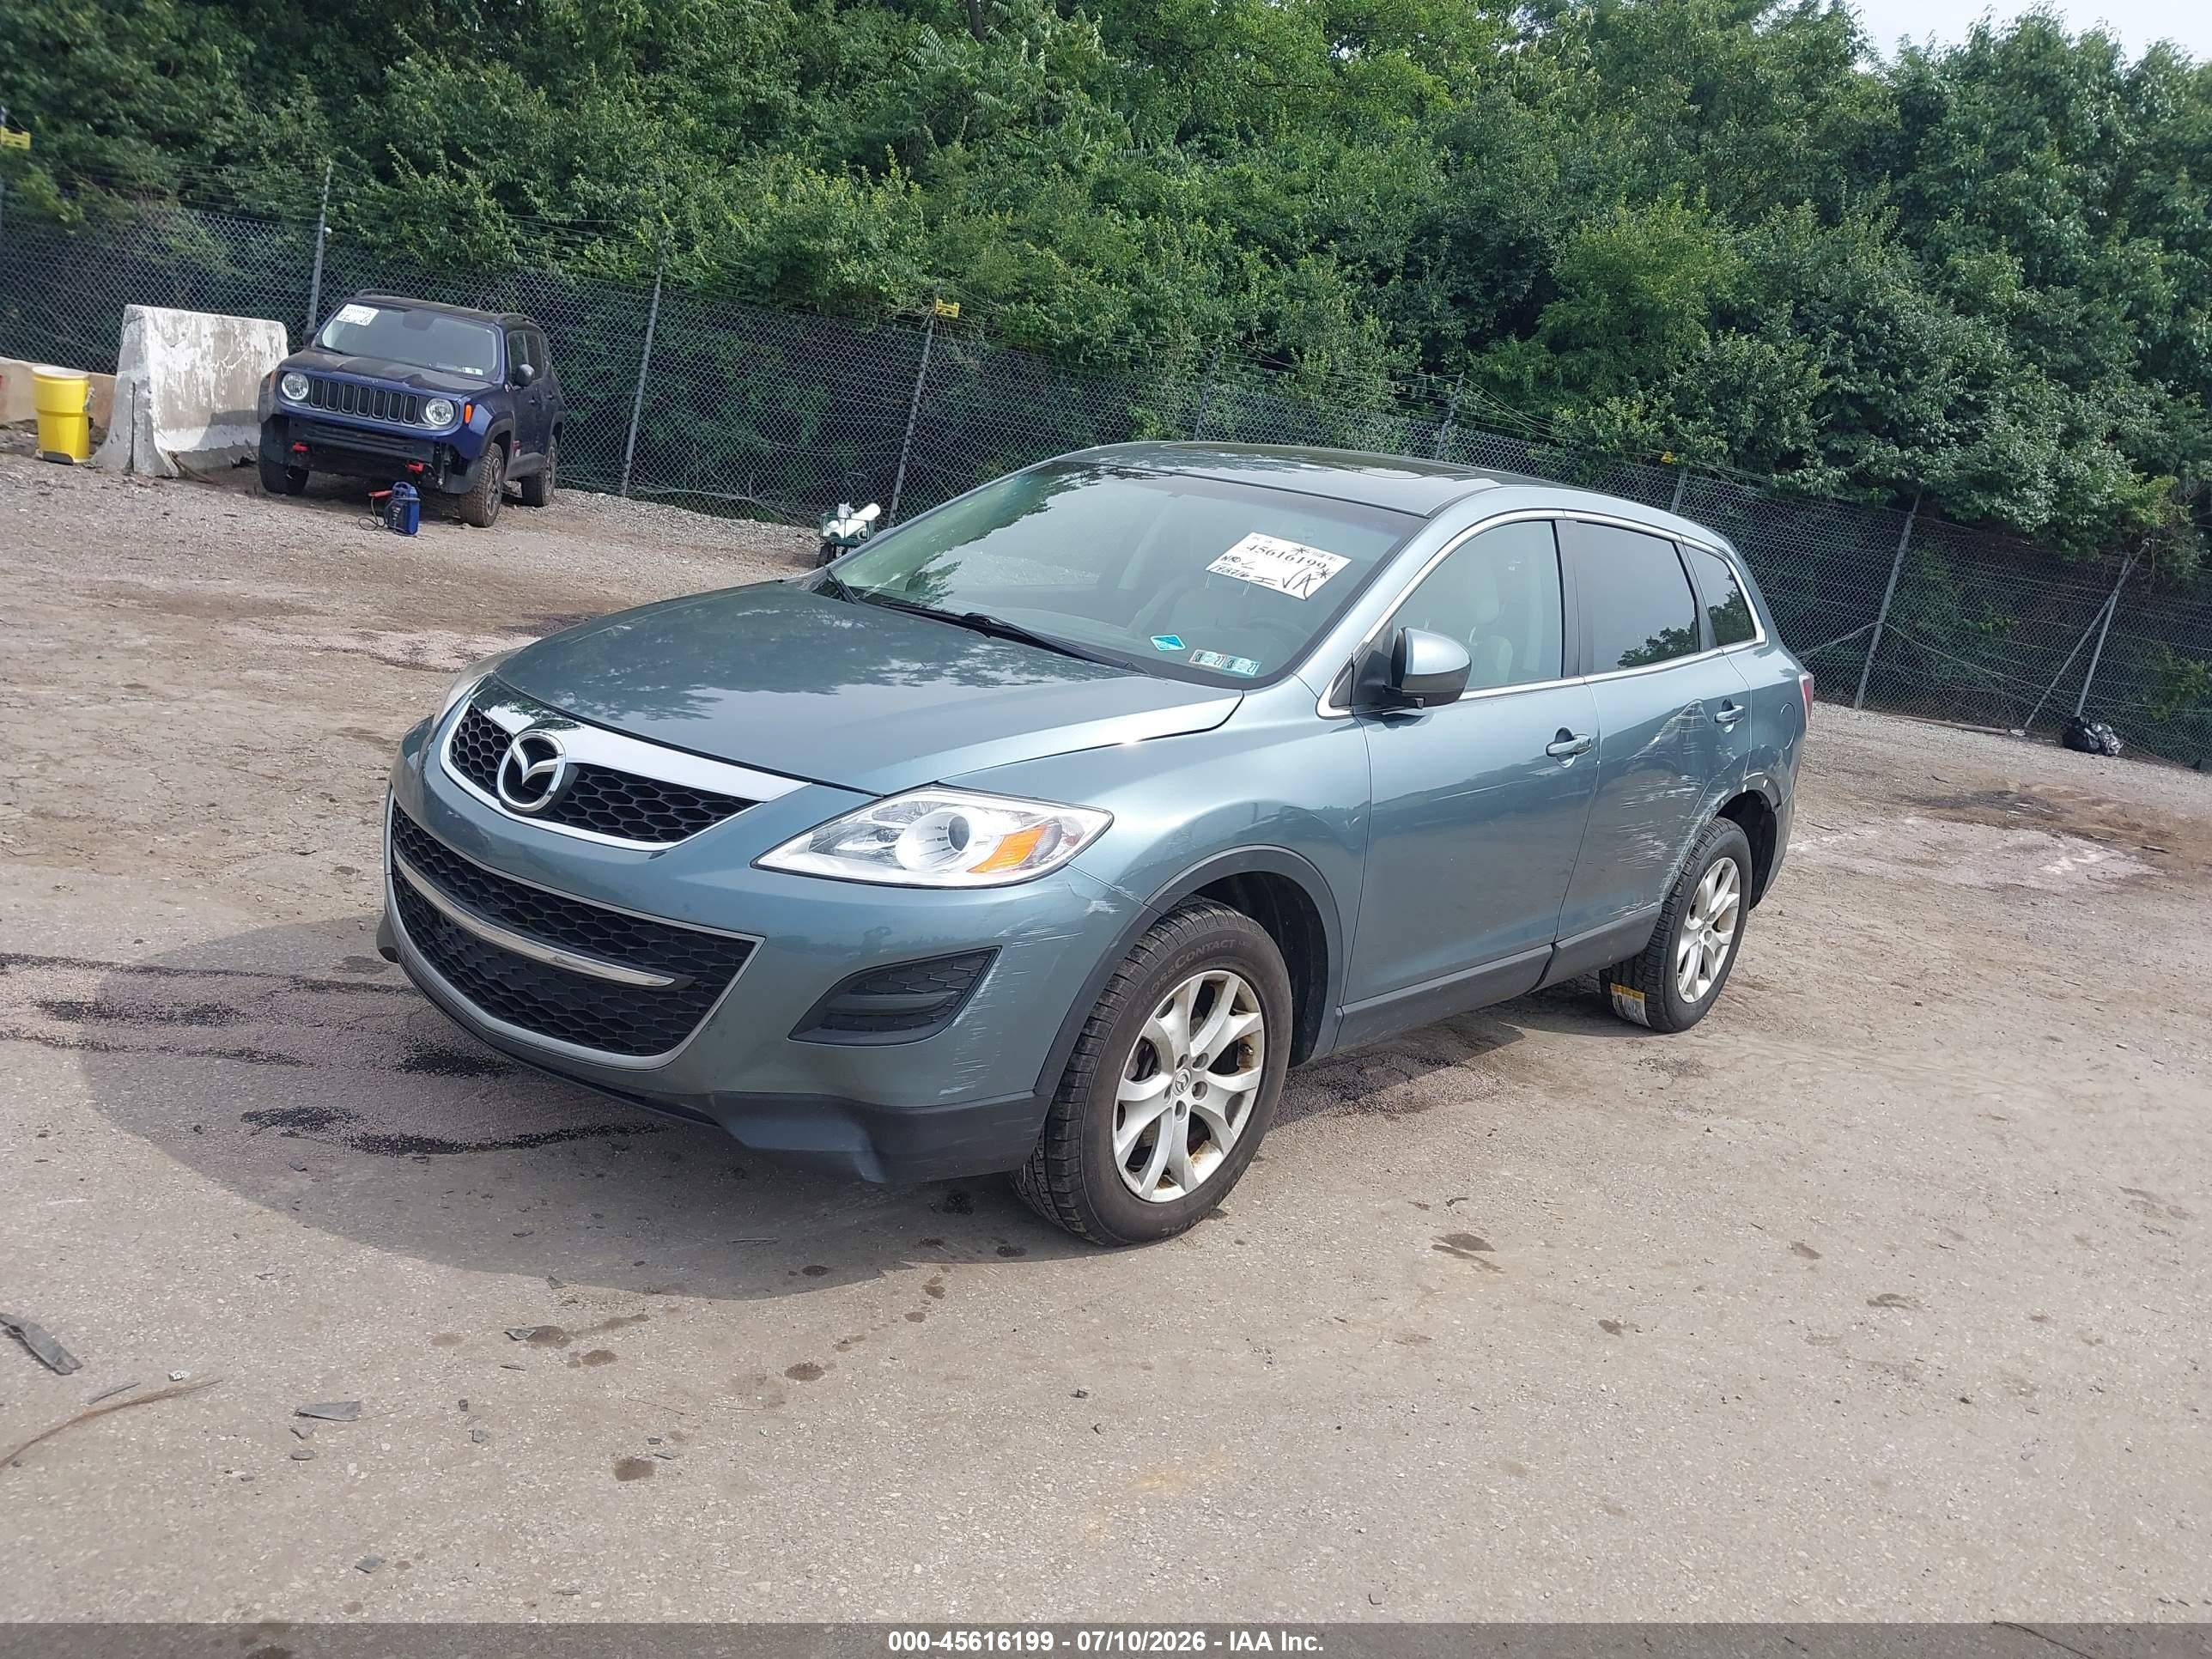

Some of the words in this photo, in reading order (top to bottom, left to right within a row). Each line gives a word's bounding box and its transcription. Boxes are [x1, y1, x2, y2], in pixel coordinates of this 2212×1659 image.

[1247, 544, 1328, 570] 45616199
[1214, 655, 1225, 666] 27
[1247, 662, 1257, 673] 27
